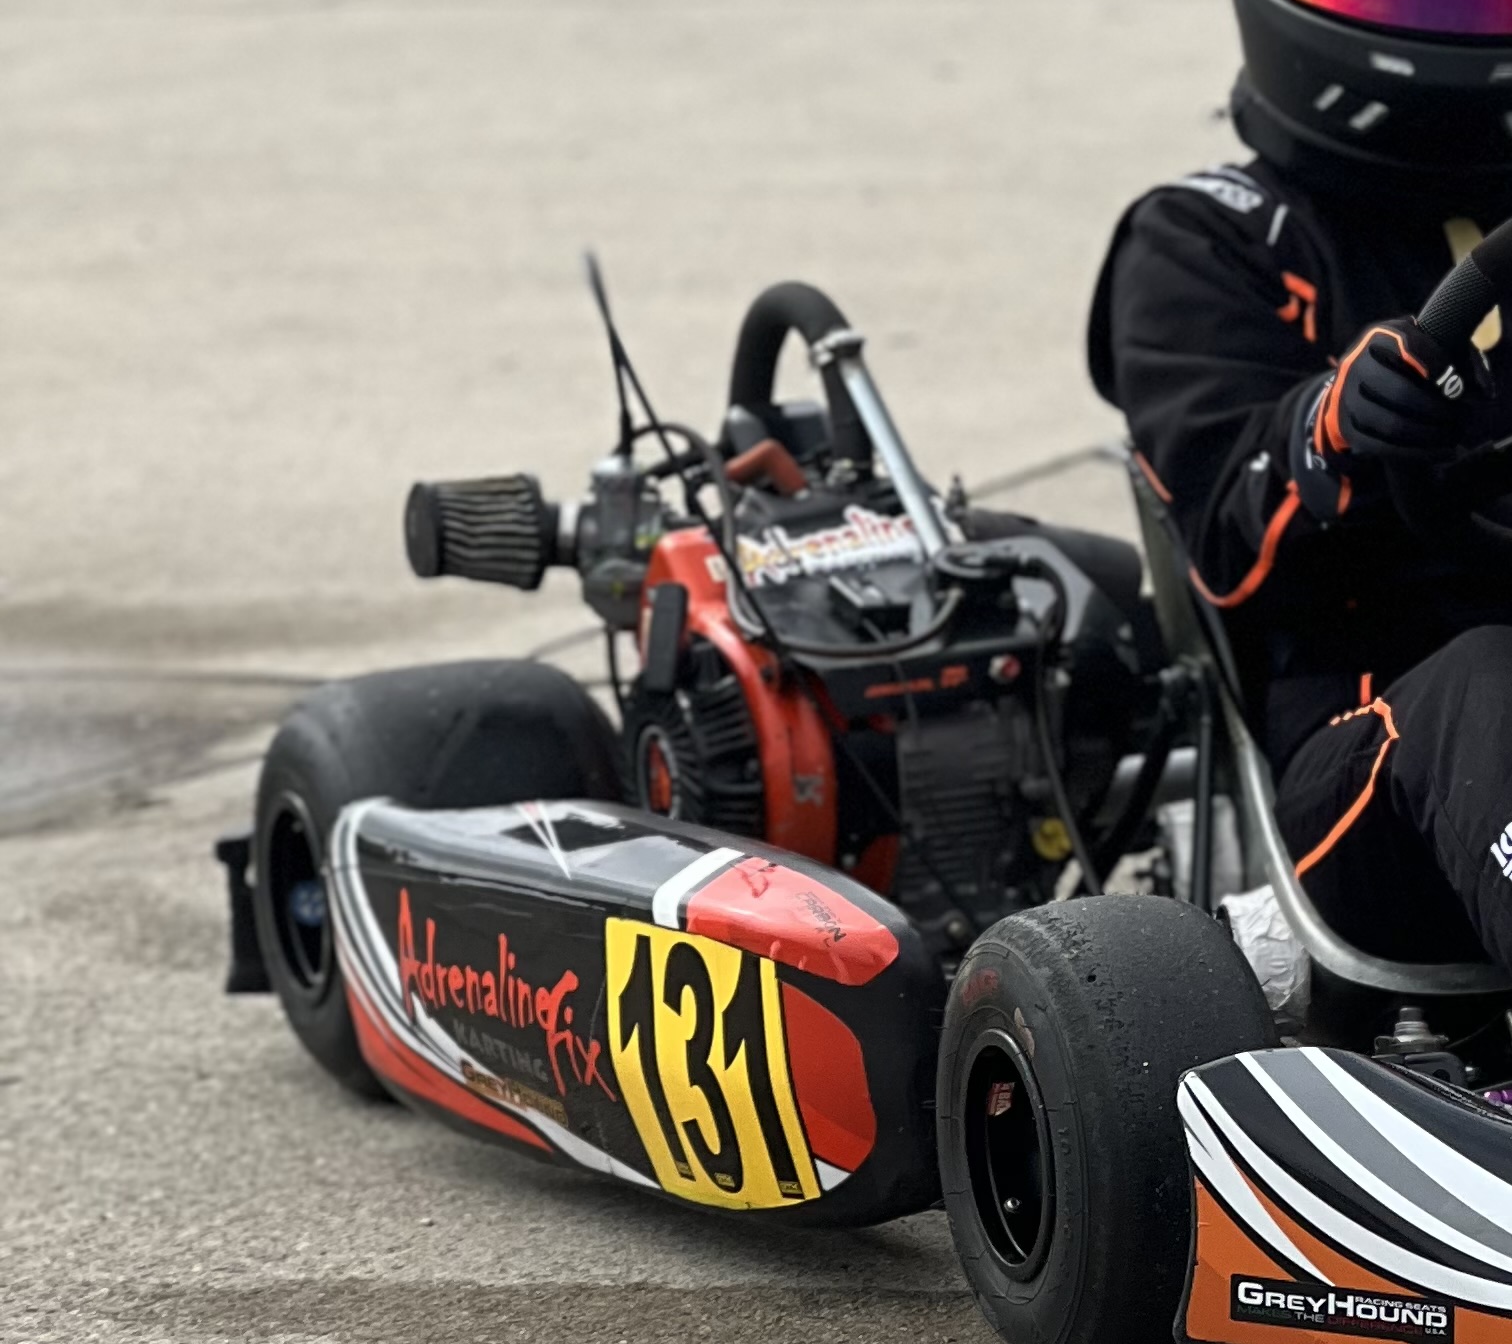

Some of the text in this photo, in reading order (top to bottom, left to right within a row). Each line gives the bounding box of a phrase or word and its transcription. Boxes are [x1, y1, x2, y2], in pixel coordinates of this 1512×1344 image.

[618, 934, 805, 1199] 131
[1355, 1296, 1447, 1314] RACING SEATS
[1295, 1311, 1325, 1324] THE
